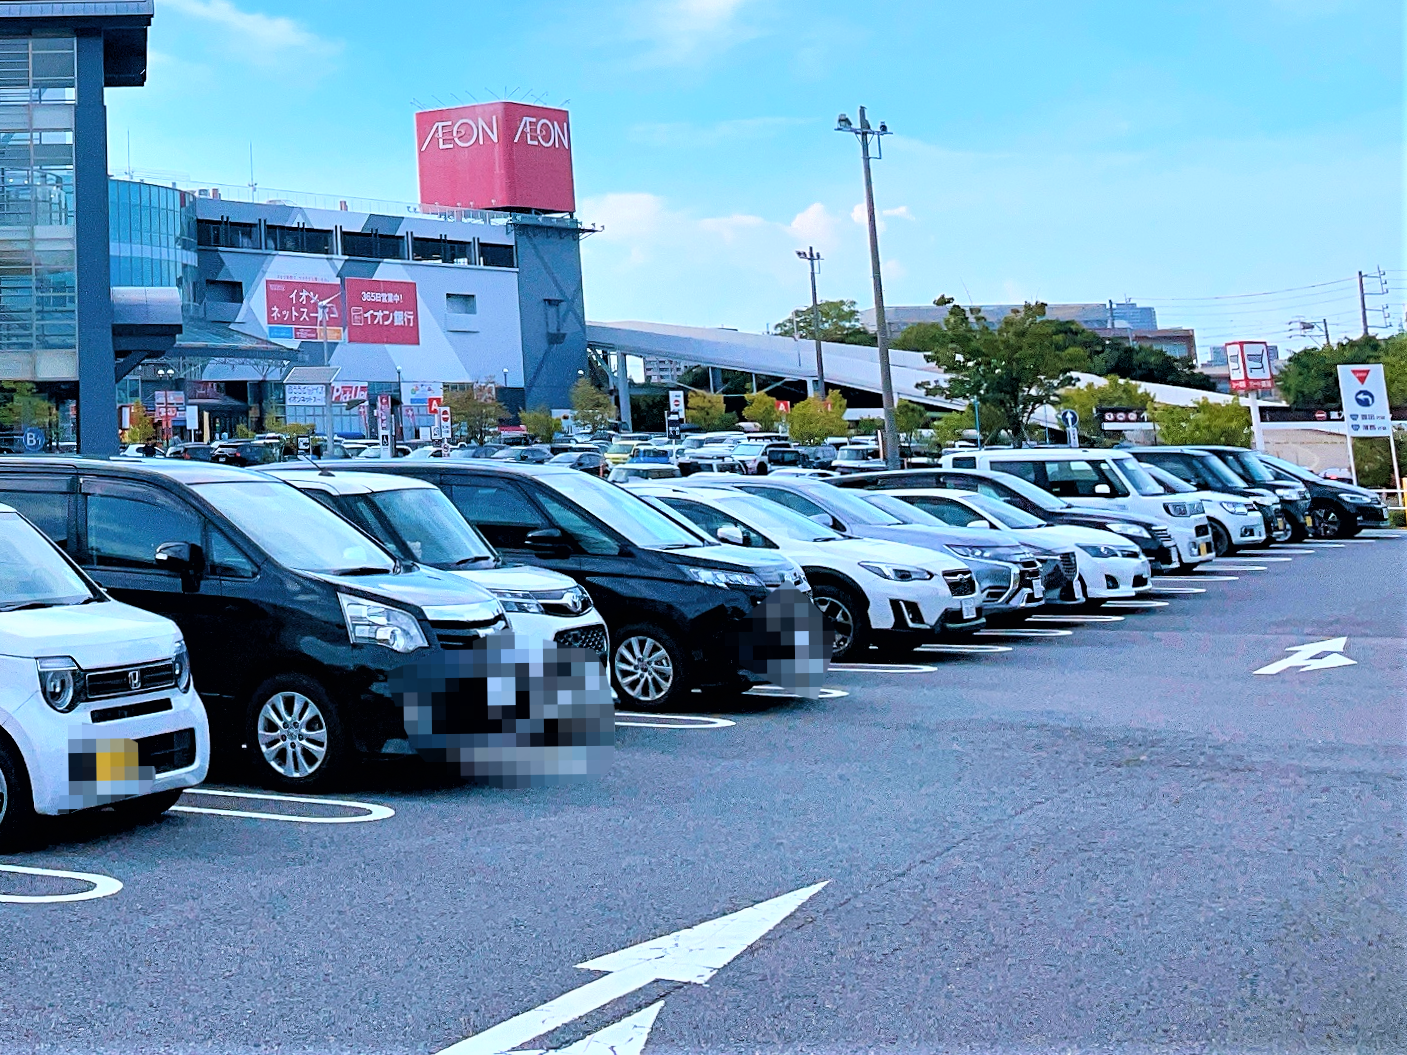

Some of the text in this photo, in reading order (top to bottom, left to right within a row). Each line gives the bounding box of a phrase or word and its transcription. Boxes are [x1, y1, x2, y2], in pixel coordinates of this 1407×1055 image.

[289, 289, 319, 305] イオン
[363, 309, 414, 327] イオン銀行
[431, 400, 439, 412] A
